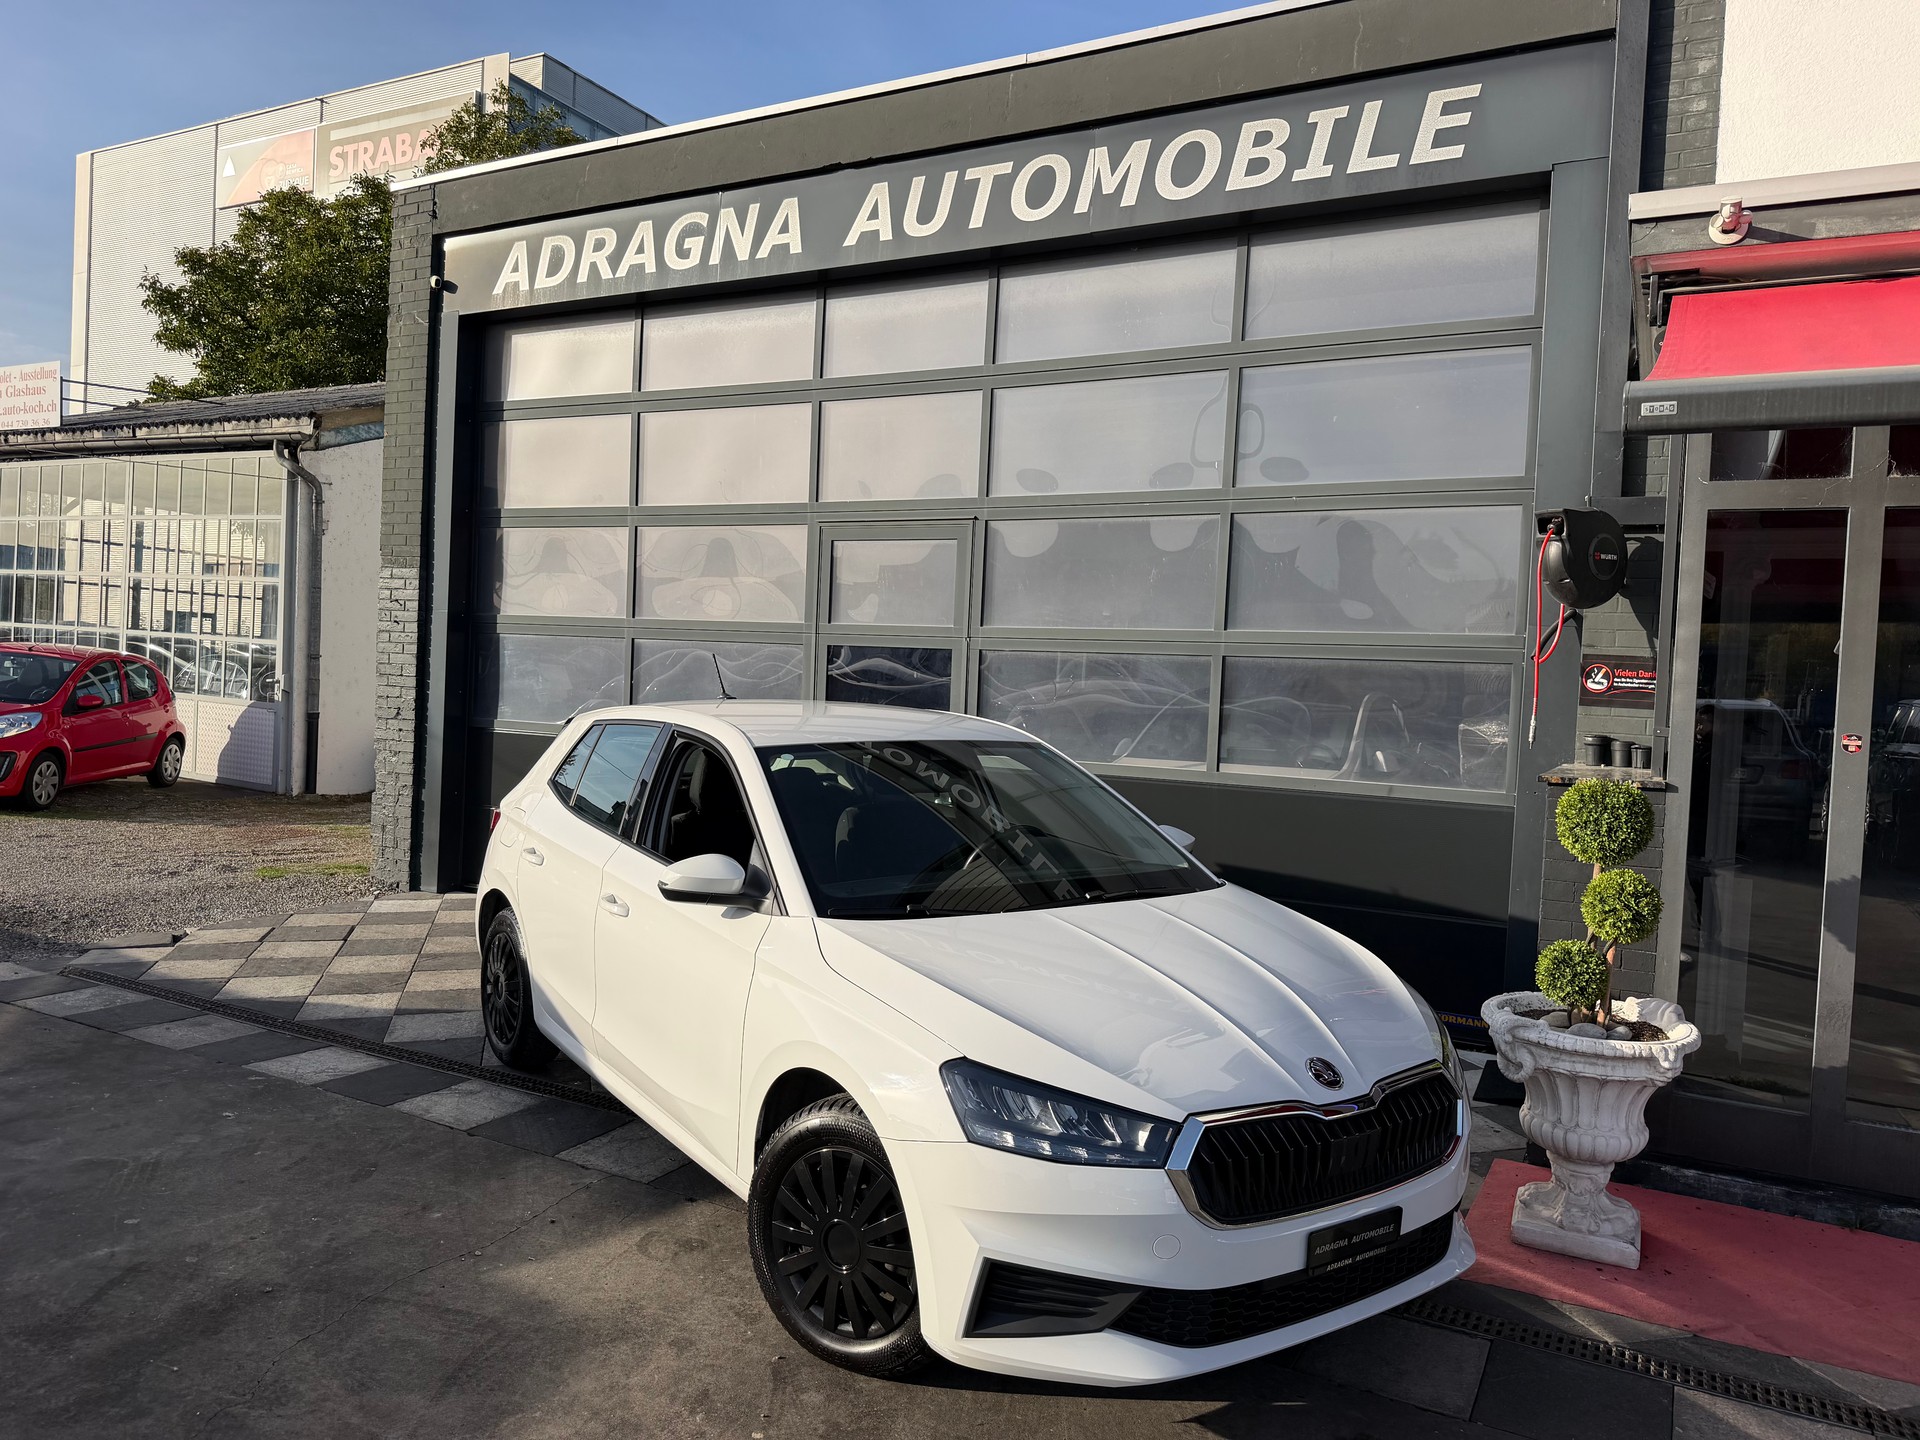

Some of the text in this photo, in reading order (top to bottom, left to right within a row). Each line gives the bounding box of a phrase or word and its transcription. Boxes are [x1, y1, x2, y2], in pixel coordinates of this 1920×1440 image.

[328, 128, 438, 177] STRABA
[491, 83, 1483, 296] ADRAGNA AUTOMOBILE
[19, 366, 57, 382] Ausstellung
[6, 384, 47, 398] Glashaus
[1614, 669, 1638, 677] Vielen
[1314, 1223, 1395, 1255] ADRAGNA AUTOMOBILE
[1326, 1245, 1388, 1271] ADRAGNA AUTOMOBILE
